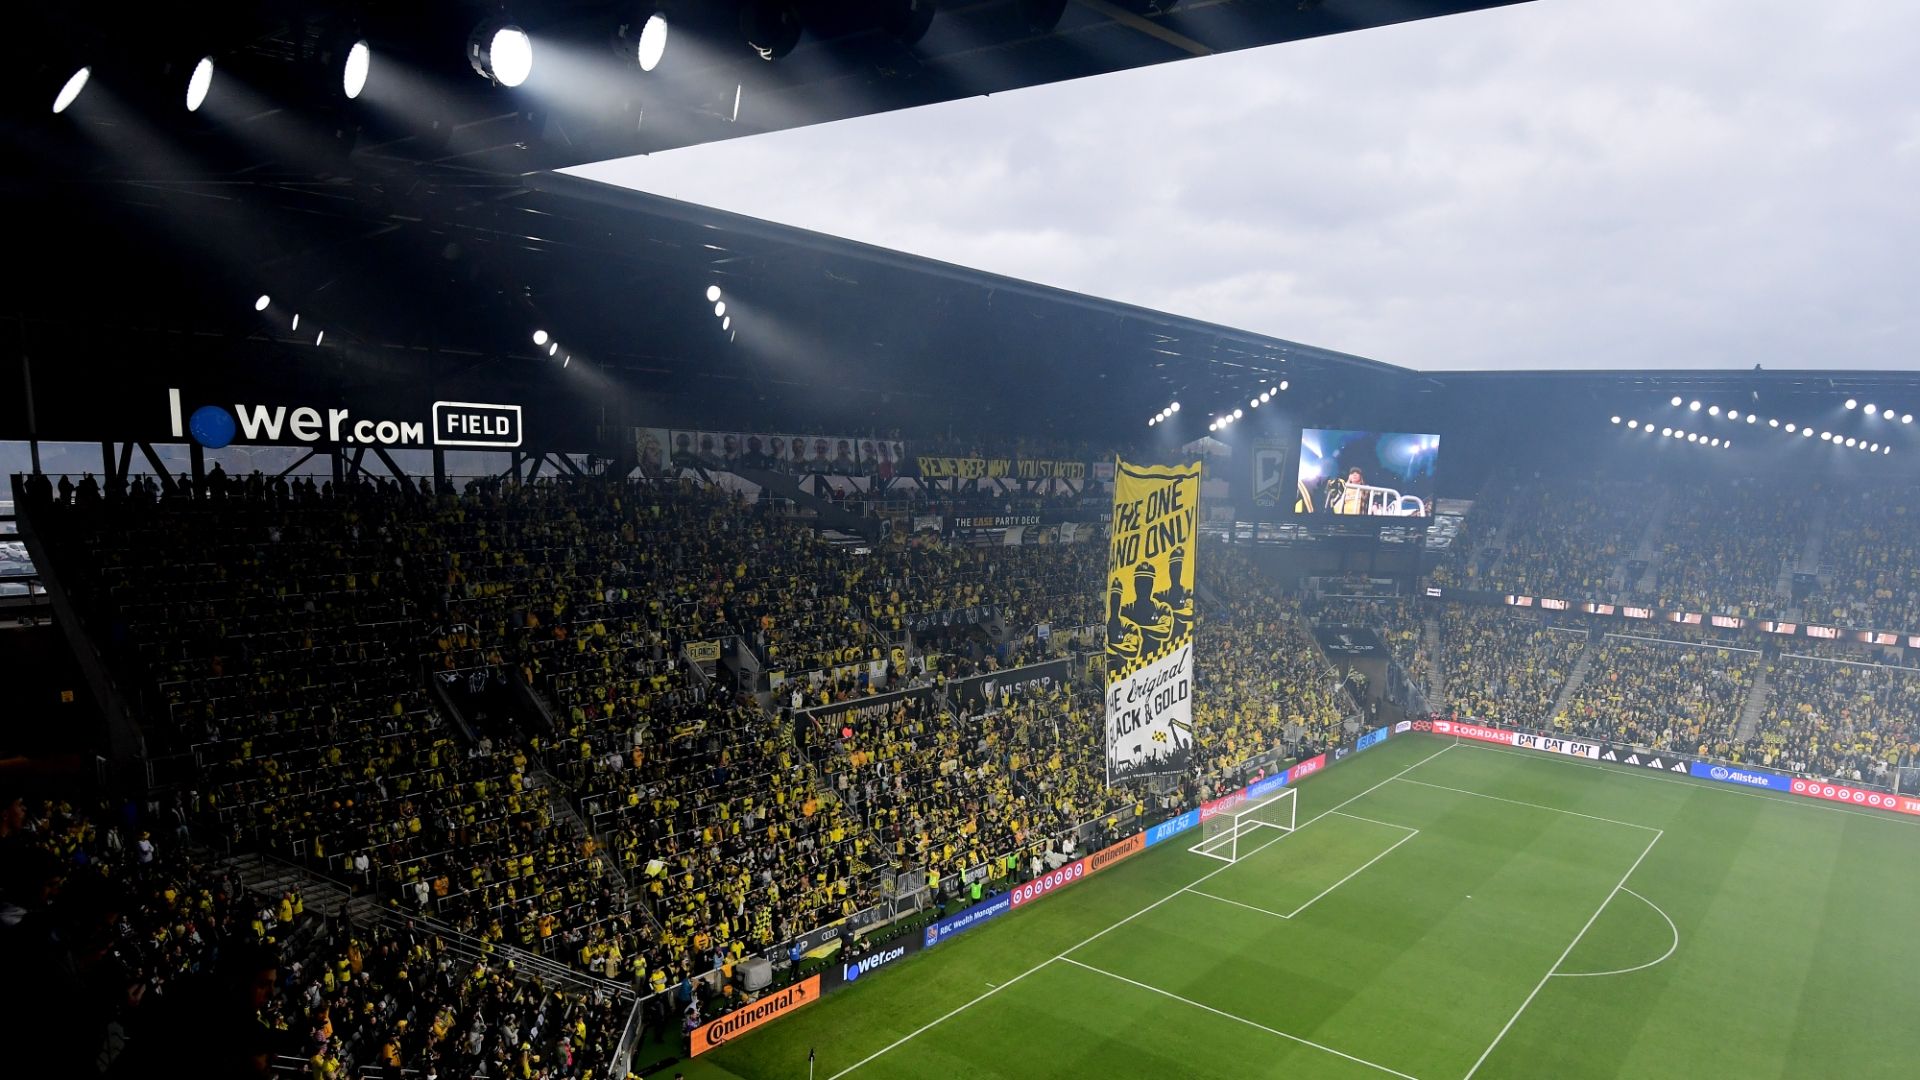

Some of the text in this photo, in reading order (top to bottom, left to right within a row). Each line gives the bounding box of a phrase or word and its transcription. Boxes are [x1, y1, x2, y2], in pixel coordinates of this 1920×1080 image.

[447, 413, 510, 436] FIELD
[918, 456, 985, 480] REMEMBER
[988, 459, 1011, 478] WHY
[1115, 477, 1184, 535] THE ONE
[955, 515, 1040, 527] THE EASE PARTY DECK
[1109, 505, 1194, 573] AND ONLY
[1127, 647, 1189, 704] Original
[1154, 679, 1188, 716] GOLD
[1453, 725, 1513, 743] DOORDASH
[1518, 734, 1538, 748] CAT
[1544, 738, 1564, 752] CAT
[1570, 743, 1592, 757] CAT
[1728, 771, 1768, 786] Allstate
[1156, 814, 1190, 839] AT&T 5G
[1090, 839, 1133, 871] Continental
[940, 898, 1009, 936] RBC Wealth Management
[706, 988, 793, 1046] Continental
